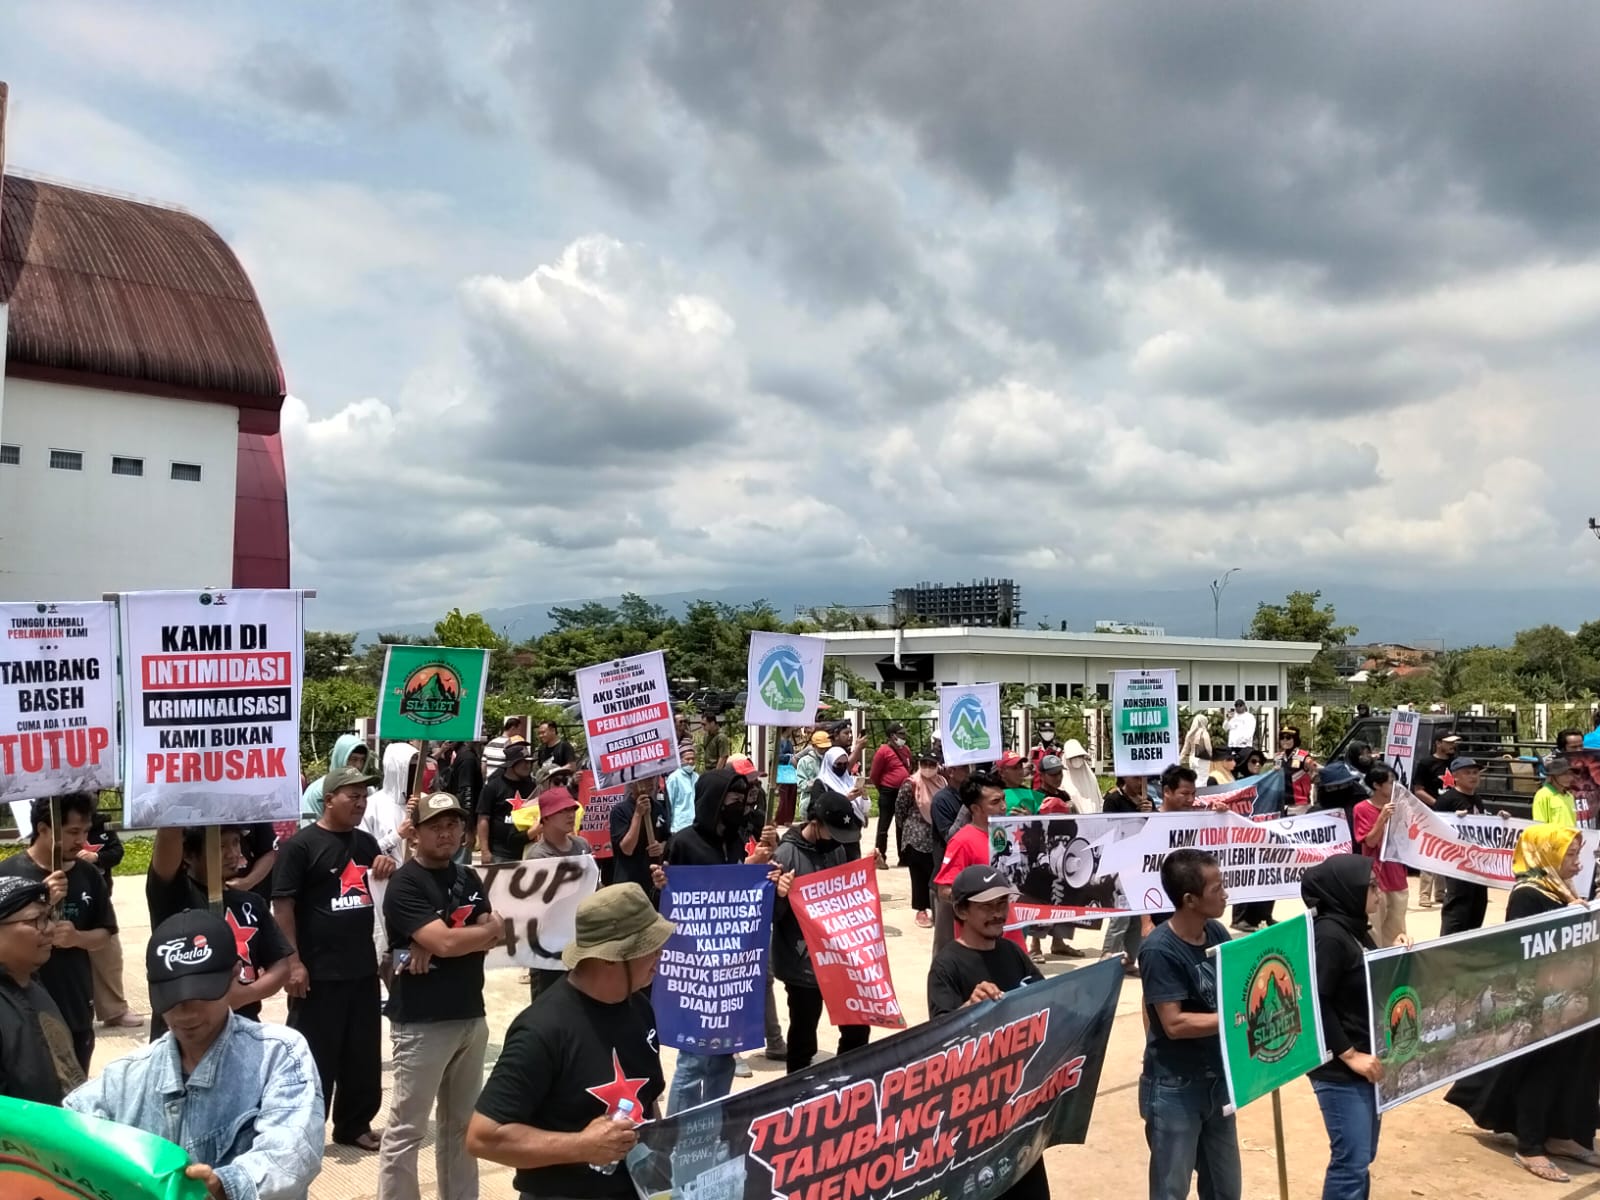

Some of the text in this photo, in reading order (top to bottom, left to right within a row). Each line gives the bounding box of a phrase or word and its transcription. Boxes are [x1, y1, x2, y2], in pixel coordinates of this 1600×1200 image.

[11, 617, 84, 628] TUNGGU KEMBALI
[8, 628, 88, 640] PERLAWANAN KAMI
[161, 624, 267, 652] KAMI DI
[0, 658, 100, 685] TAMBANG
[148, 657, 285, 685] INTIMIDASI
[18, 686, 84, 713] BASEH
[593, 680, 656, 704] AKU SIAPKAN
[149, 695, 287, 719] KRIMINALISASI
[406, 700, 455, 711] SLAMET
[603, 694, 650, 714] UNTUKMU
[1123, 698, 1168, 708] KONSERVASI
[17, 716, 87, 731] CUMA ADA 1 KATA
[597, 707, 661, 732] PERLAWANAN
[1129, 710, 1162, 726] HIJAU
[160, 726, 273, 748] KAMI BUKAN
[609, 730, 657, 753] BASEH TOLAK
[1122, 731, 1170, 745] TAMBANG
[0, 727, 109, 775] TUTUP
[607, 744, 664, 769] TAMBANG
[1131, 747, 1163, 760] BASEH
[146, 747, 287, 784] PERUSAK
[586, 805, 614, 813] MELA
[1230, 800, 1252, 815] ATU
[583, 814, 609, 822] ELAM
[1169, 829, 1199, 848] KAMI
[1199, 827, 1229, 846] TIDAK
[1231, 827, 1267, 844] TAKUT
[1420, 832, 1466, 863] TUTUP
[1228, 847, 1257, 866] LEBIH
[1258, 847, 1295, 865] TAKUT
[800, 869, 867, 901] TERUSLAH
[1221, 866, 1306, 889] GUBUR DESA BAS
[672, 889, 763, 904] DIDEPAN MATA
[806, 888, 876, 919] BERSUARA
[670, 904, 762, 920] ALAM DIRUSAK
[822, 906, 877, 934] KARENA
[714, 919, 762, 934] APARAT
[696, 937, 741, 951] KALIAN
[1520, 929, 1557, 960] TAK
[660, 948, 764, 967] DIBAYAR RAKYAT
[816, 948, 865, 967] MILIK
[659, 964, 761, 982] UNTUK BEKERJA
[667, 979, 756, 998] BUKAN UNTUK
[680, 996, 743, 1013] DIAM BISU
[700, 1015, 729, 1029] TULI
[1253, 1012, 1296, 1046] SLAMET
[751, 1011, 1049, 1153] TUTUP PERMANEN
[771, 1059, 1026, 1188] TAMBANG BATU
[787, 1057, 1087, 1200] MENOLAK TAMBANG
